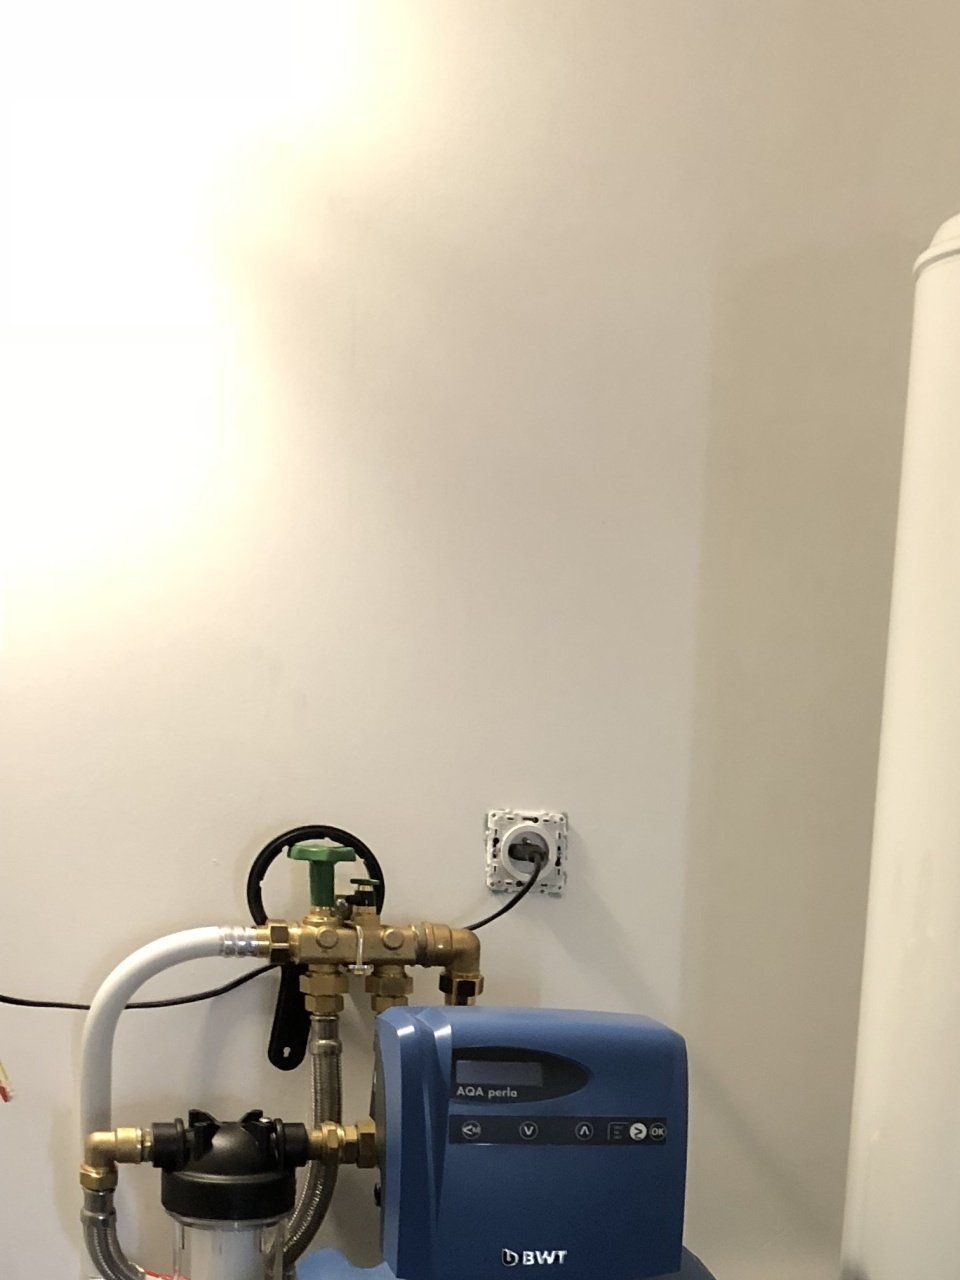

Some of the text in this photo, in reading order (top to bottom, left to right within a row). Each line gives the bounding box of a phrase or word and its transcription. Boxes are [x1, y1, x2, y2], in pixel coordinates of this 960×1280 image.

[456, 1086, 518, 1100] AQA perla
[651, 1126, 665, 1137] OK
[522, 1250, 568, 1265] BWT
